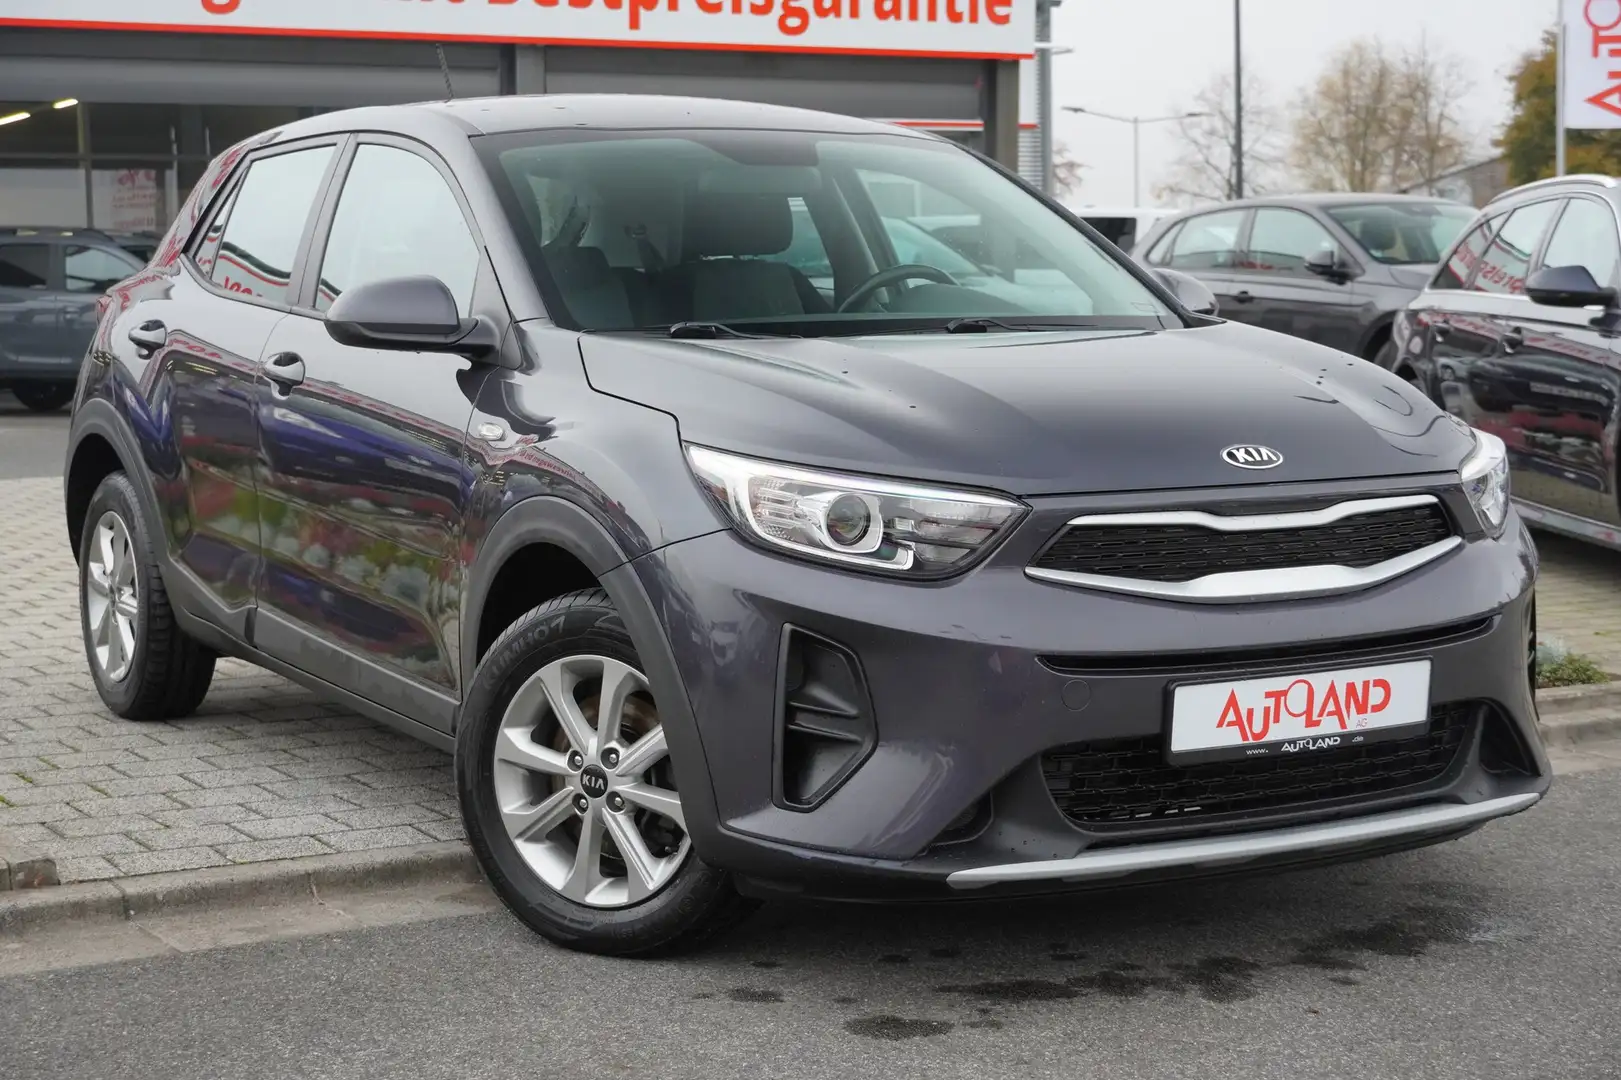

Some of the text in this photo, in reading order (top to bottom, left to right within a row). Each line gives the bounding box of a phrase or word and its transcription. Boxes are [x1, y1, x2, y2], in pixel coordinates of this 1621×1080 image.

[1216, 678, 1391, 742] AUTOLAND
[1355, 718, 1368, 729] AG
[1281, 736, 1341, 753] AUTOLAND
[582, 773, 605, 790] KIA
